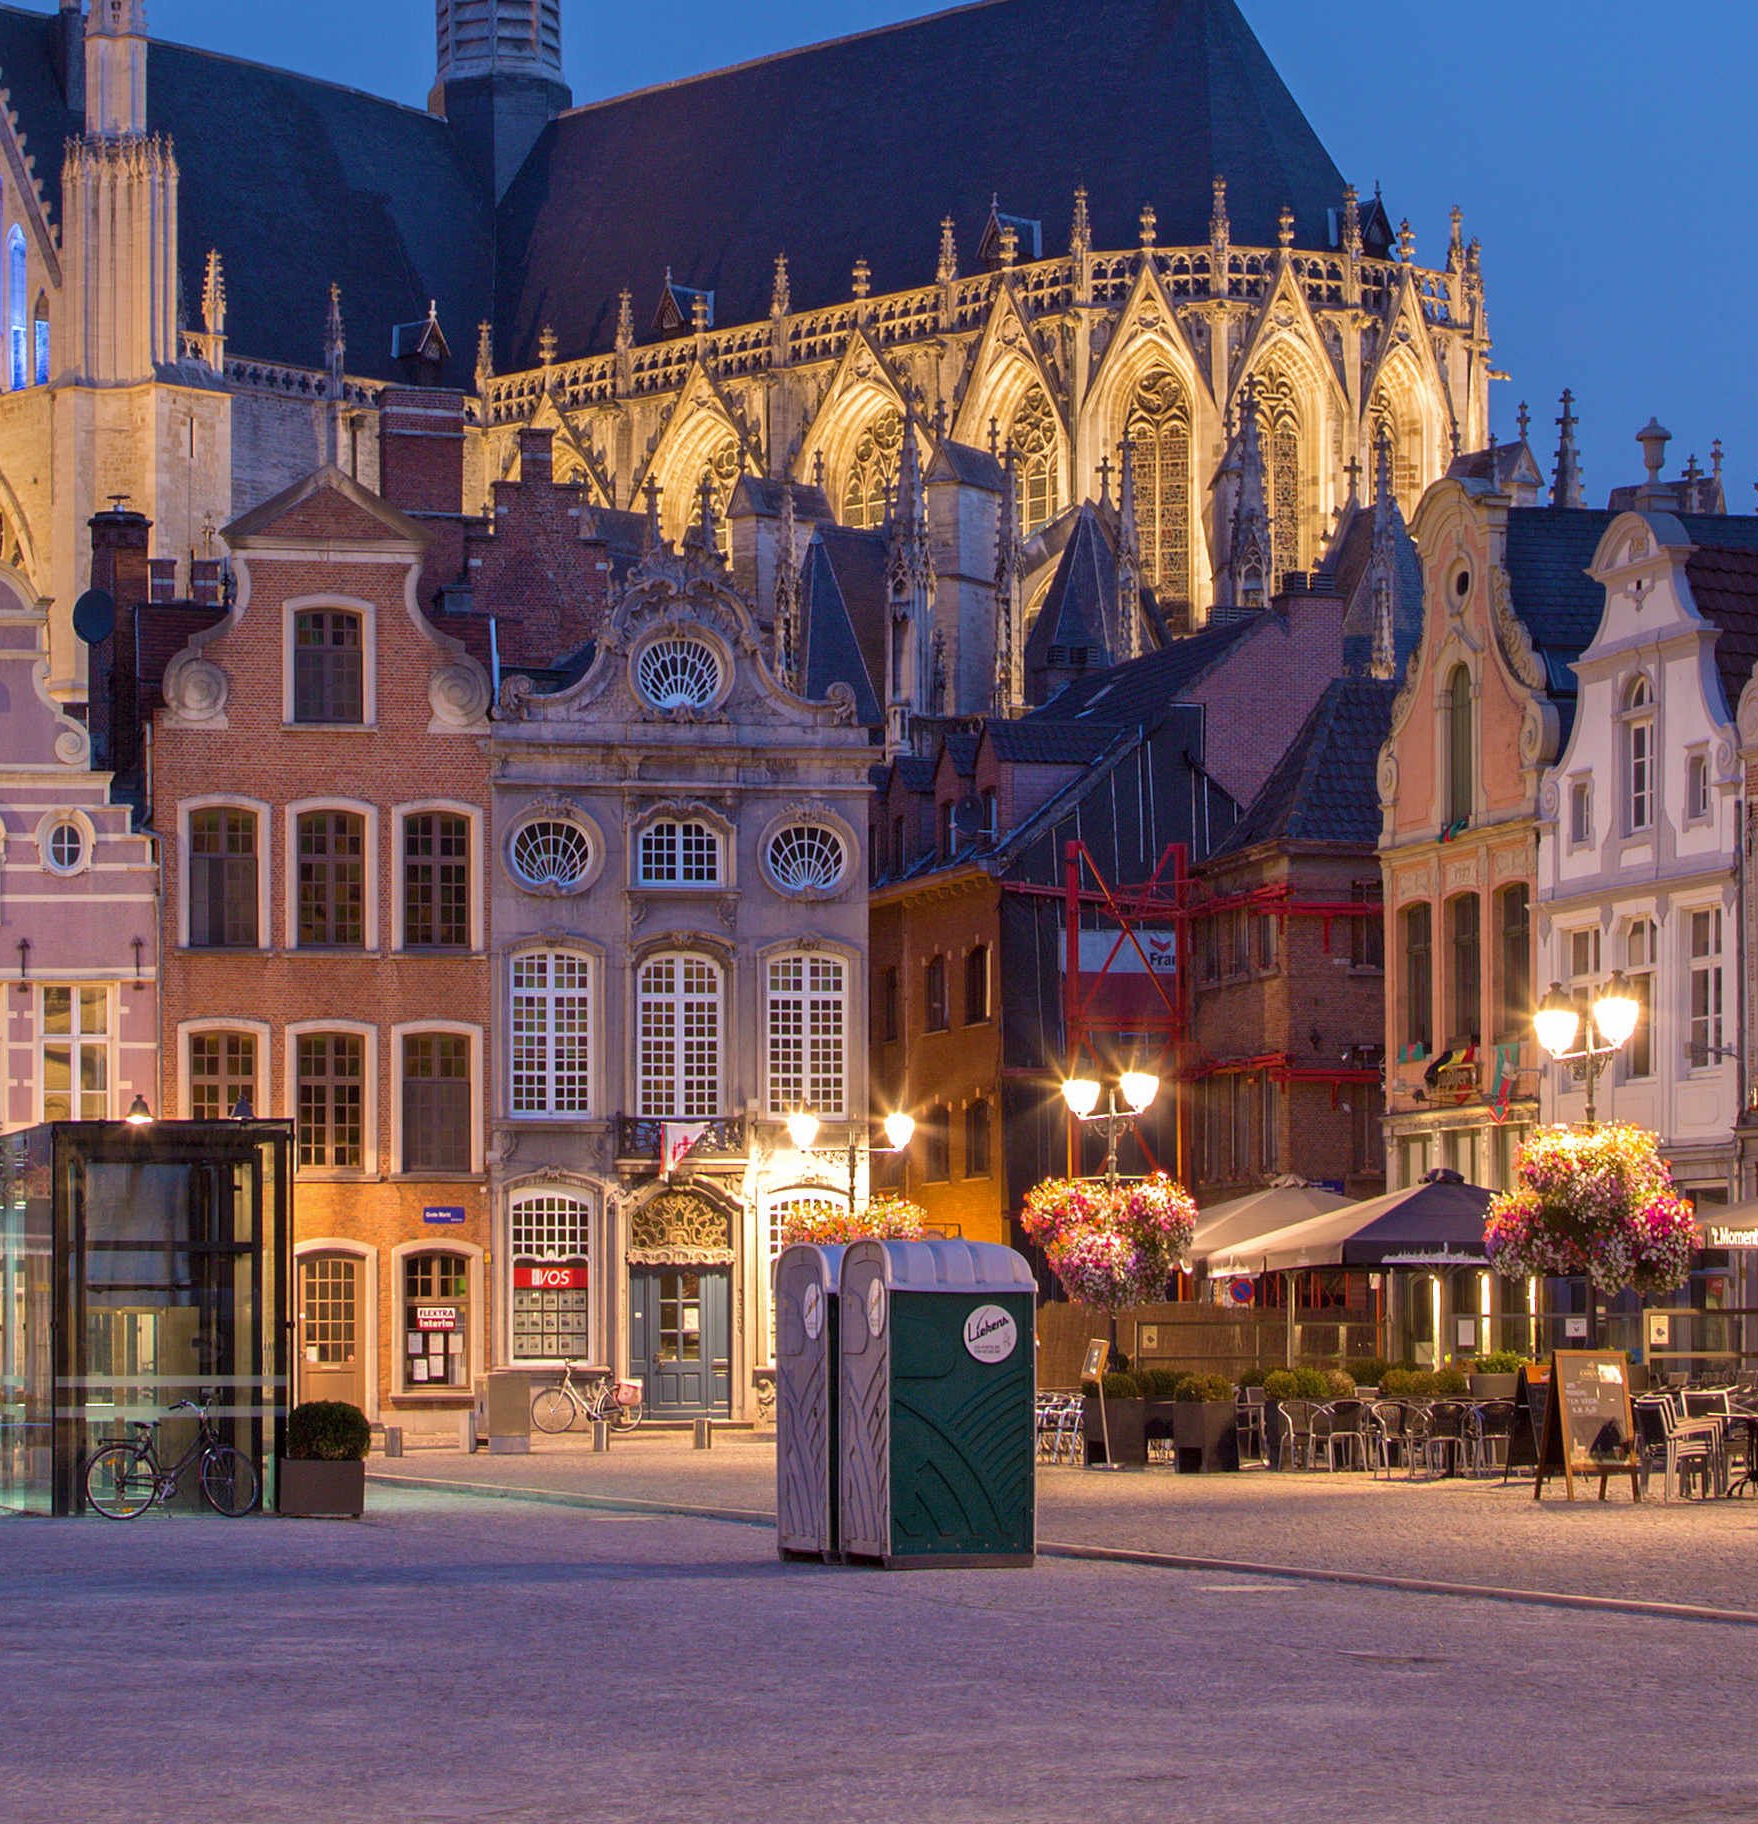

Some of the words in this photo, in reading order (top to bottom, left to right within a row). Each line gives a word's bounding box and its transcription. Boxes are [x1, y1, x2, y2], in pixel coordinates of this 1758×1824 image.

[540, 1269, 570, 1285] VOS
[419, 1309, 454, 1317] FLEXTRA
[419, 1319, 455, 1328] interim
[968, 1308, 1010, 1343] Liekens
